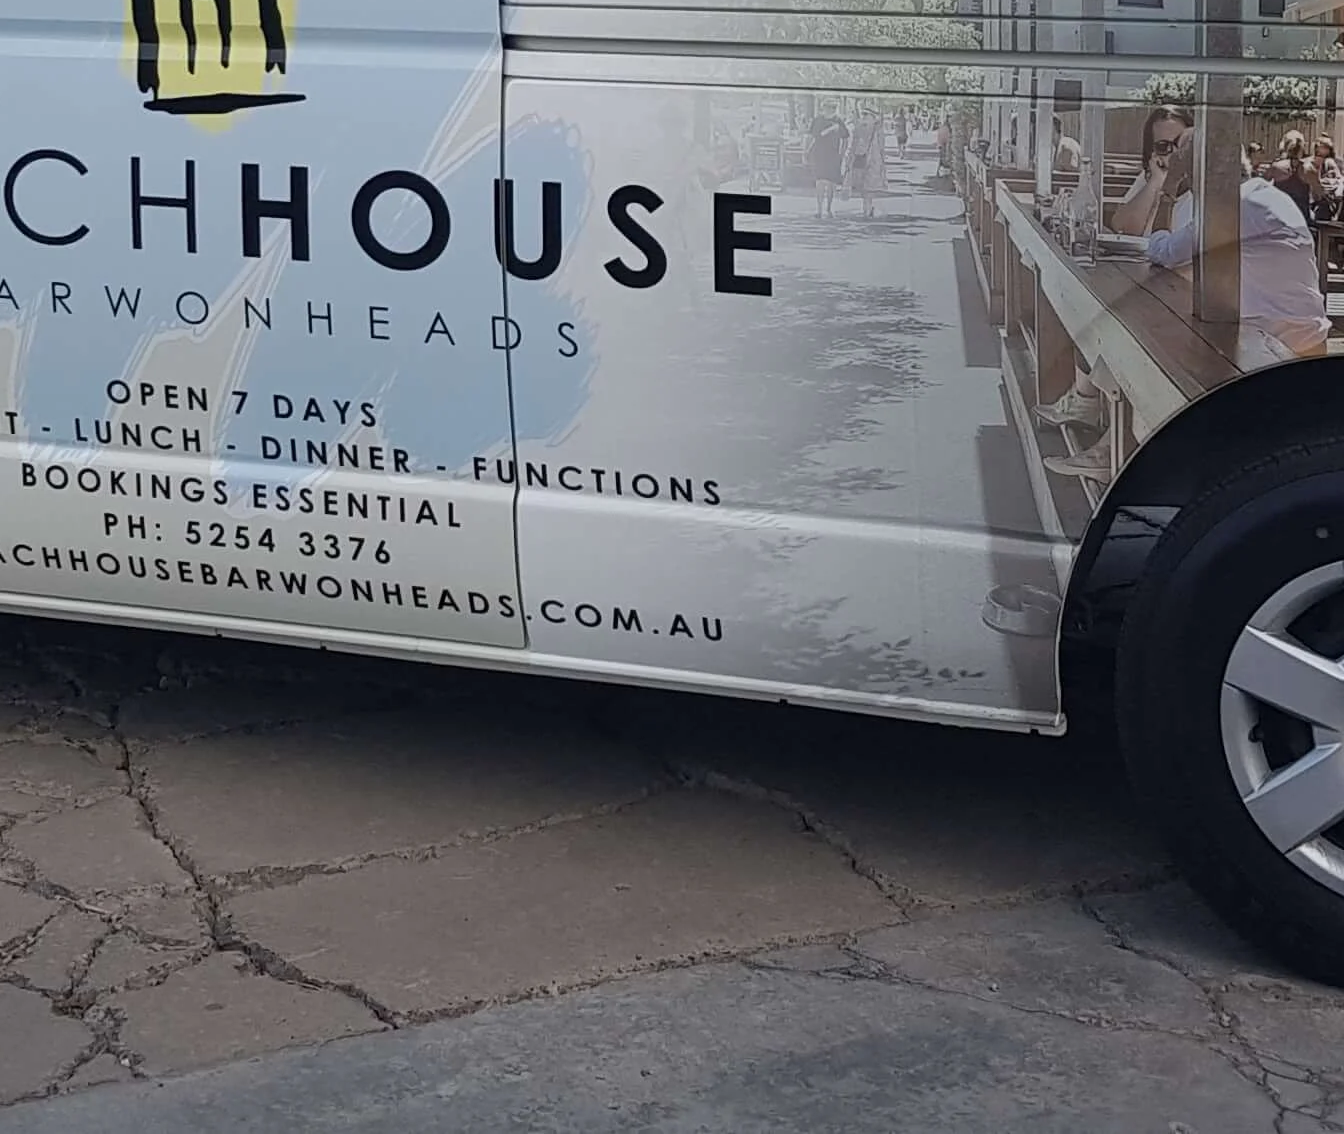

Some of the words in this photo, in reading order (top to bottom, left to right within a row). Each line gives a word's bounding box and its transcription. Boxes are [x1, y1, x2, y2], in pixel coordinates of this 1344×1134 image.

[107, 380, 207, 411] OPEN
[232, 391, 248, 414] 7
[274, 395, 375, 427] DAYS
[75, 418, 200, 452] LUNCH
[262, 436, 410, 473] DINNER
[474, 454, 720, 505] FUNCTIONS
[22, 463, 227, 505] BOOKINGS
[253, 484, 460, 527] ESSENTIAL
[104, 513, 163, 542] PH:
[186, 521, 275, 552] 5254
[300, 532, 390, 564] 3376
